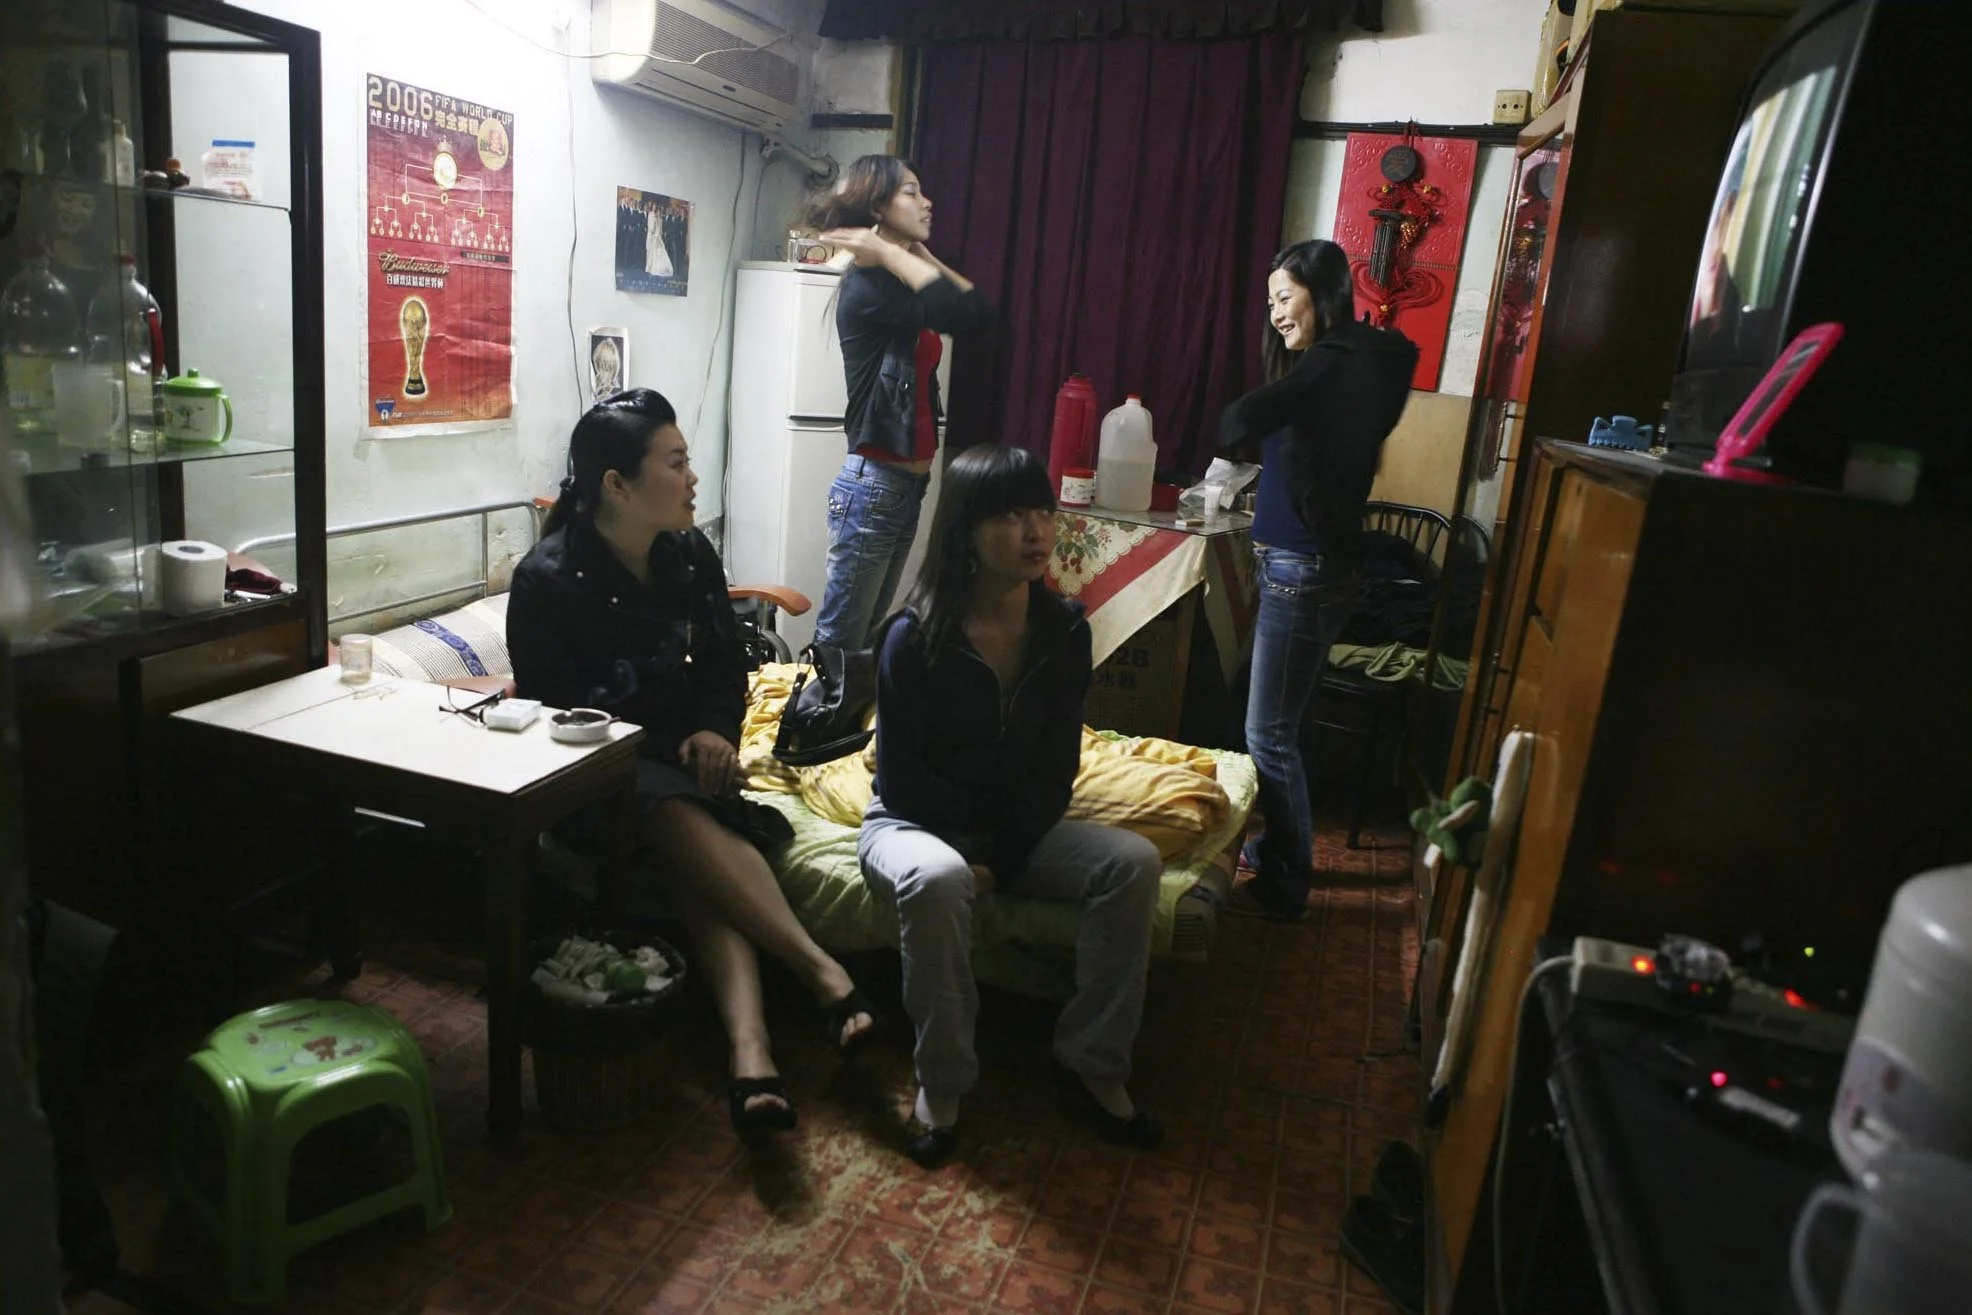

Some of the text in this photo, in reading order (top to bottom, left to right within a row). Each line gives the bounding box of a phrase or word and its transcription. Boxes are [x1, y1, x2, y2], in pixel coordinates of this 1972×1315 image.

[368, 76, 433, 121] 2006
[435, 94, 513, 126] FIFA WORLD CUP
[378, 250, 450, 275] Budweiser
[1108, 646, 1150, 668] 2B
